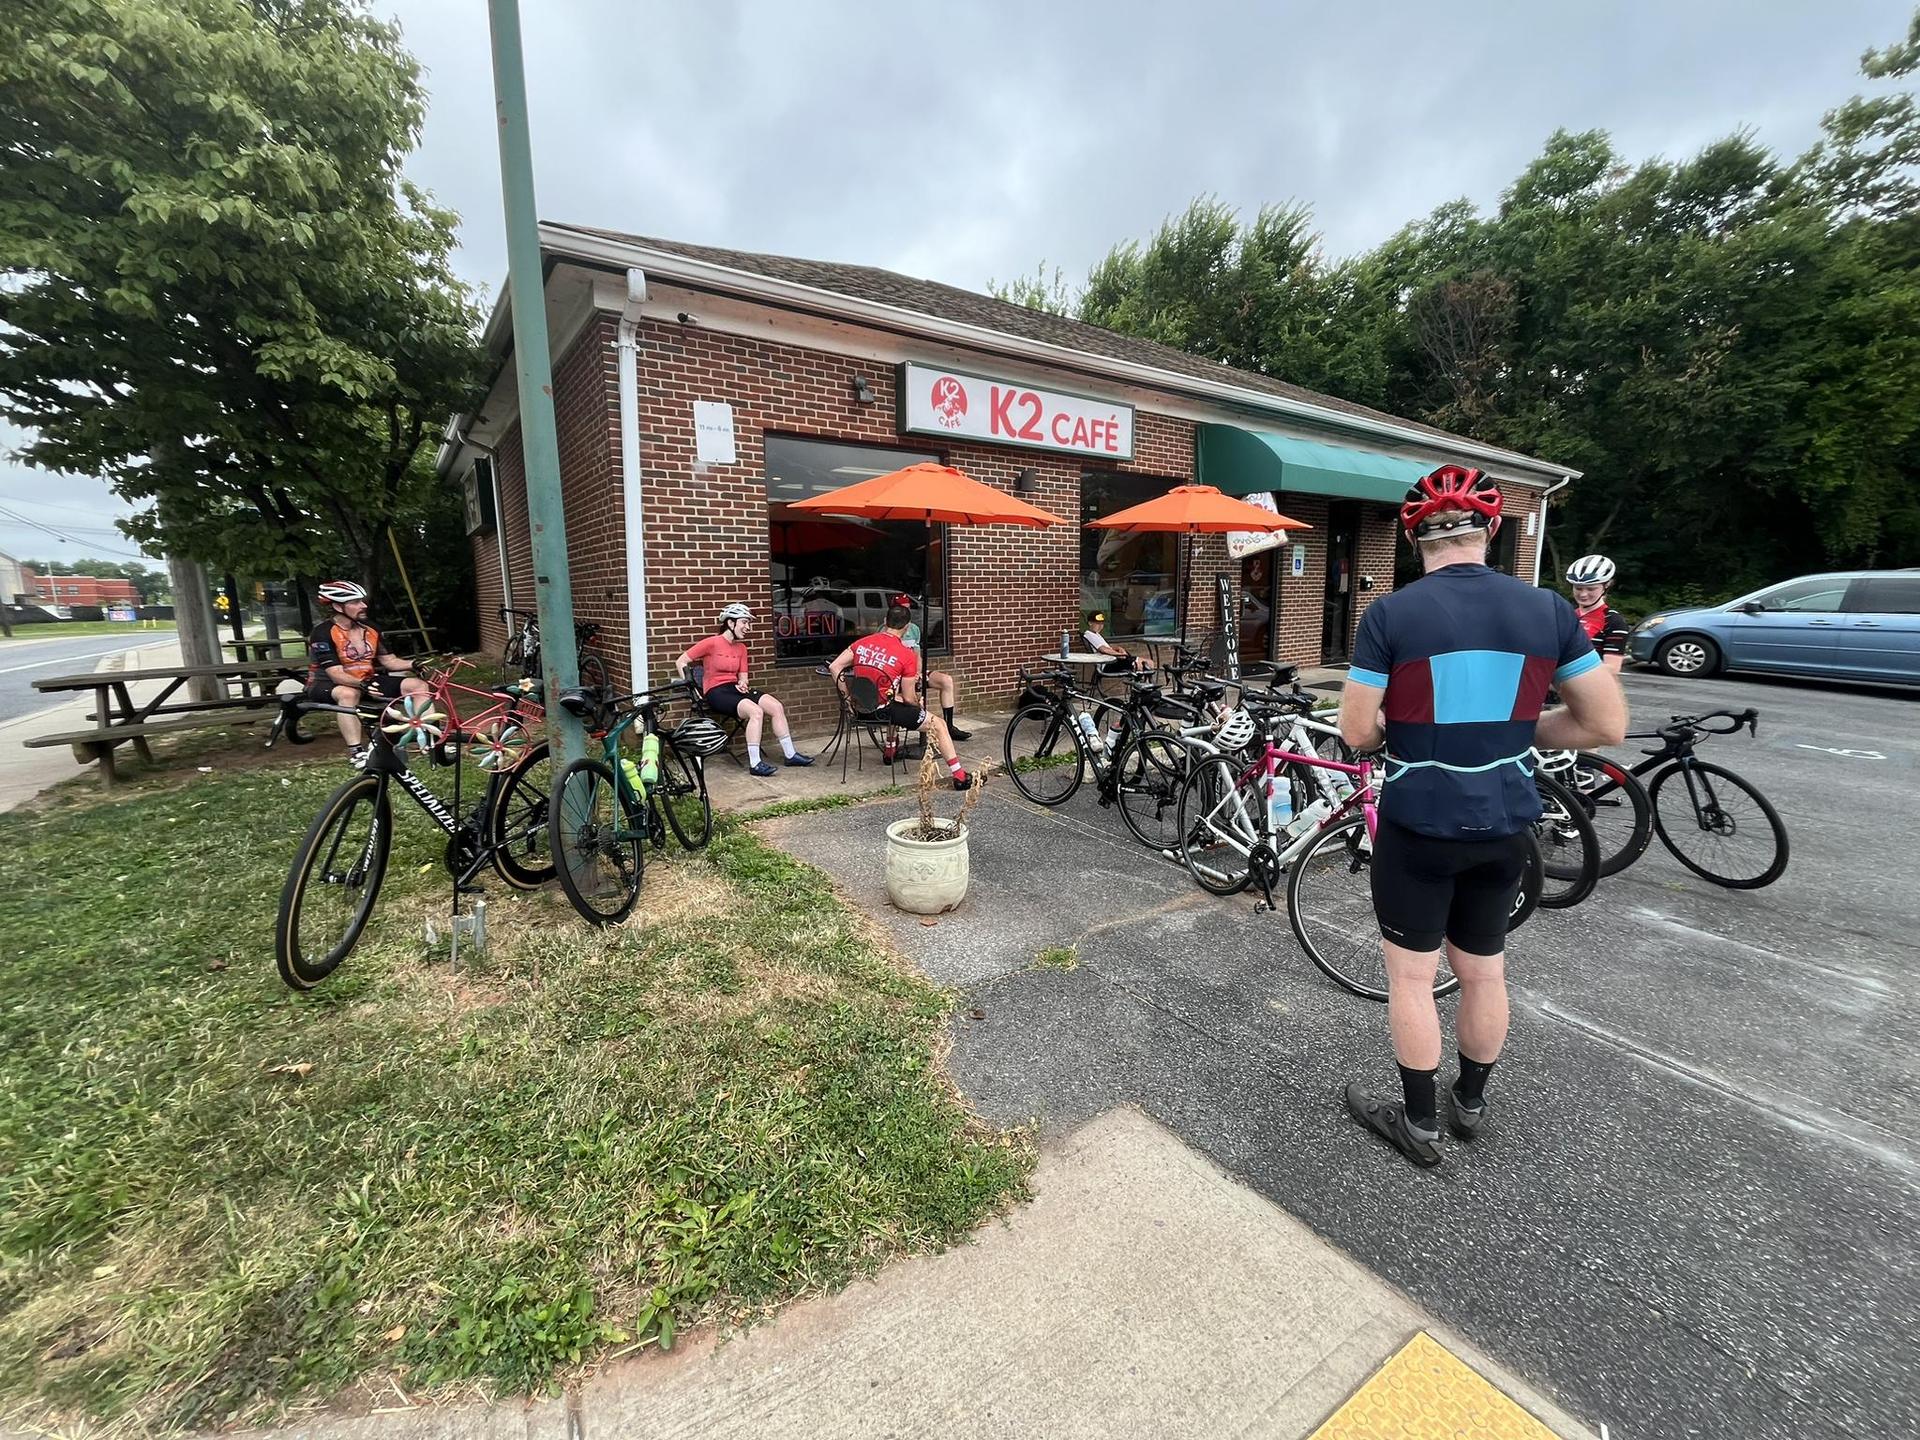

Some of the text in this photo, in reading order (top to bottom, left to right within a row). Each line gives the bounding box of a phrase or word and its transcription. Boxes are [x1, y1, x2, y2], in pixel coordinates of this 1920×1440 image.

[940, 379, 960, 399] K2
[990, 386, 1119, 452] K2 CAFÉ
[1220, 578, 1239, 681] WELCOME
[856, 644, 898, 667] BICYCLE
